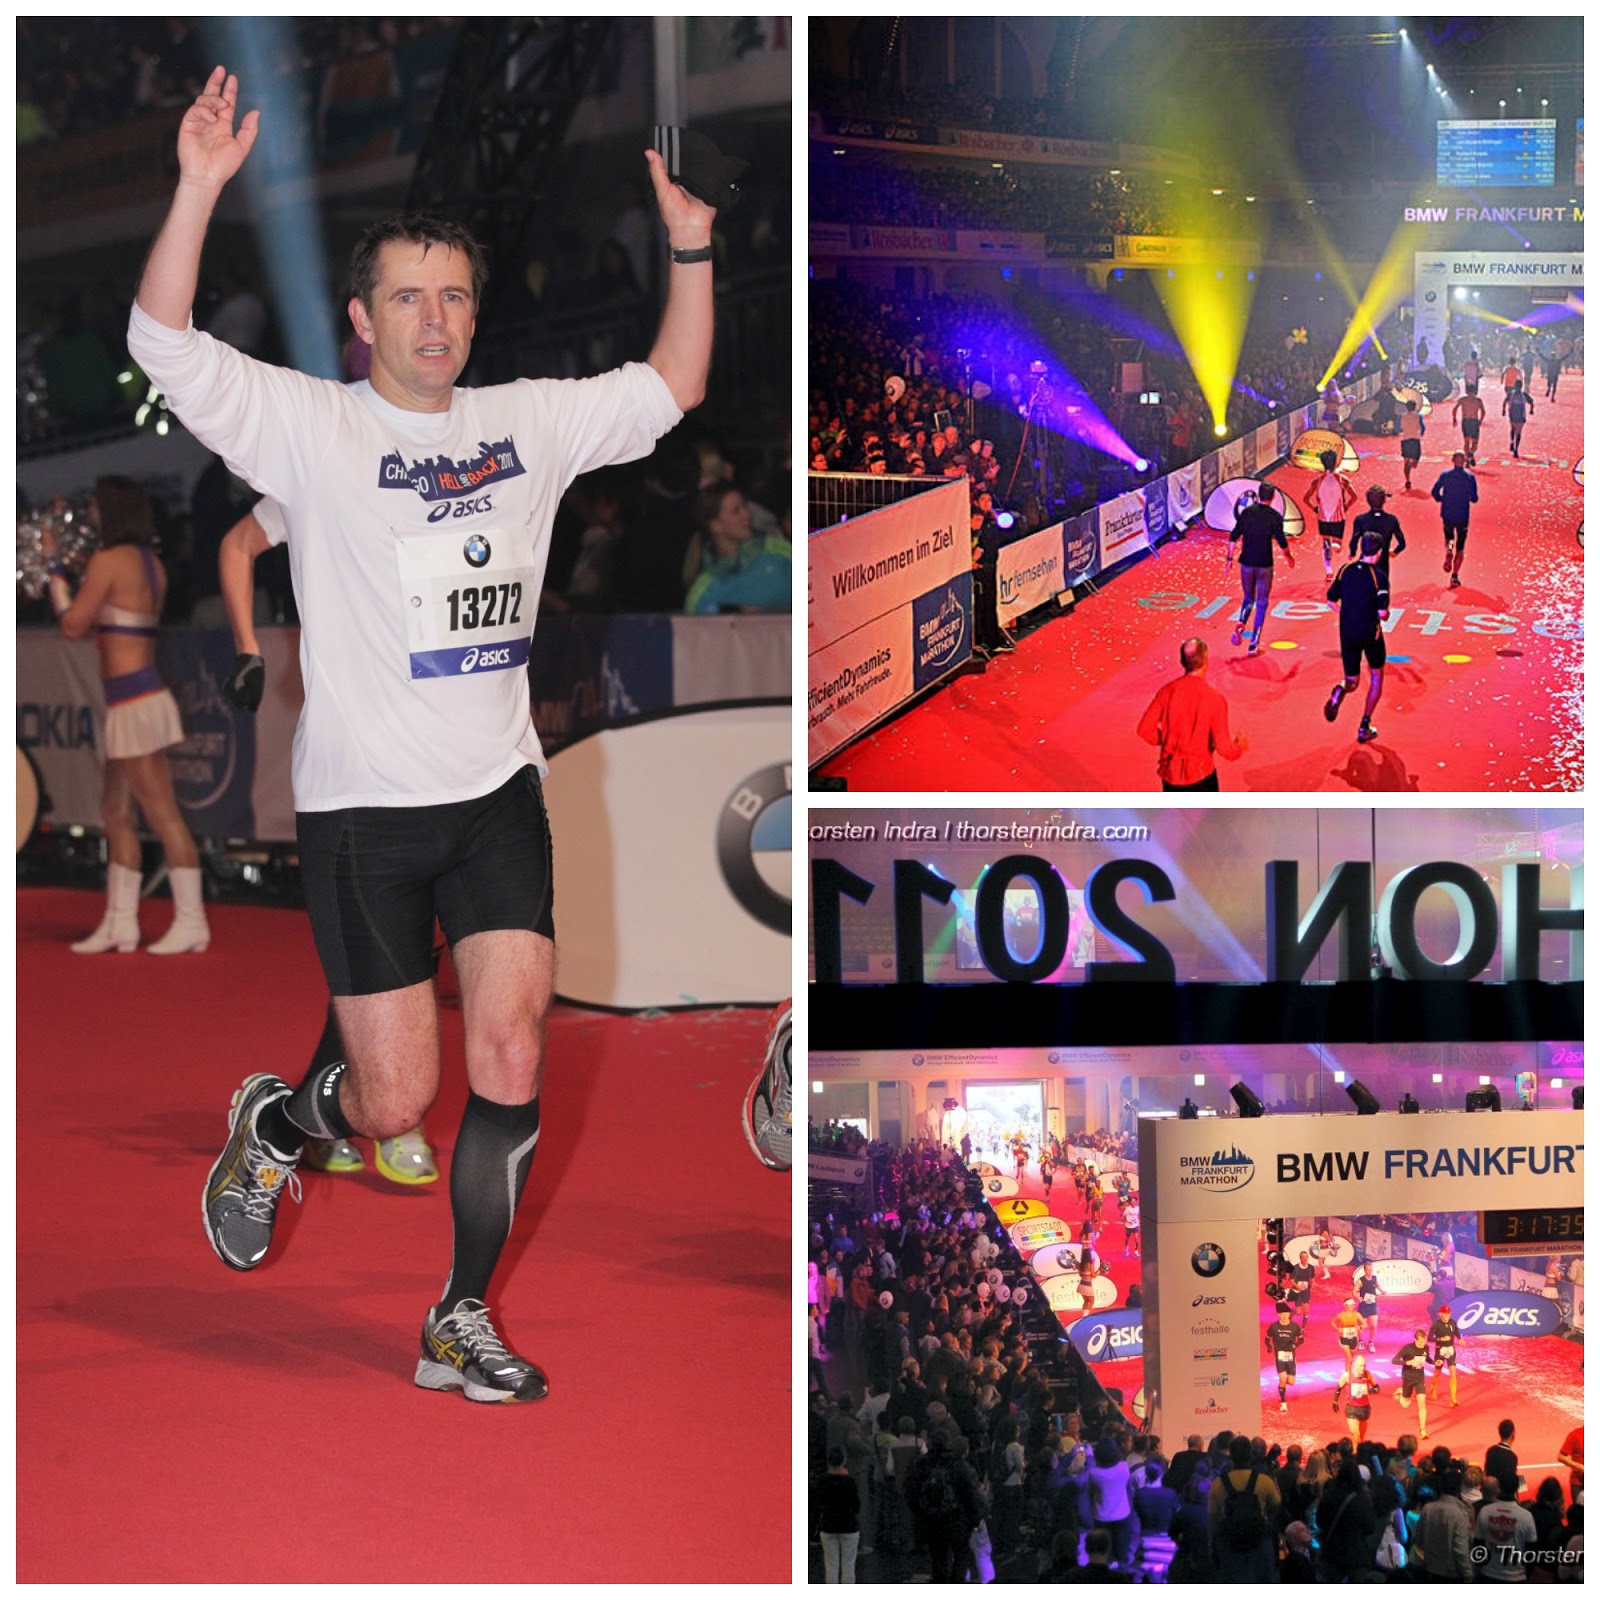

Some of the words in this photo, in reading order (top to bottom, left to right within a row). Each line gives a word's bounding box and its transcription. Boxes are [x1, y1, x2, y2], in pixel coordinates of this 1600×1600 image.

[1404, 208, 1448, 222] BMW
[1456, 207, 1566, 222] FRANKFURT
[1453, 263, 1486, 275] BMW
[1490, 263, 1567, 275] FRANKFURT
[438, 472, 464, 490] HELL
[467, 456, 500, 486] BACK
[497, 451, 515, 471] 2011
[453, 494, 493, 518] asics
[832, 548, 914, 599] Willkommen
[916, 539, 930, 559] im
[932, 525, 954, 553] Ziel
[447, 582, 522, 632] 13272
[919, 617, 940, 640] BMW
[480, 648, 510, 667] asics
[1180, 1156, 1211, 1167] BMW
[1276, 1151, 1369, 1183] BMW
[1191, 1166, 1249, 1176] FRANKFURT
[1180, 1176, 1238, 1185] MARATHON
[1510, 1245, 1545, 1253] FRANKFURT
[1380, 1275, 1421, 1287] sthalle
[1051, 1289, 1108, 1303] festle
[1203, 1296, 1226, 1305] asics
[1484, 1307, 1540, 1326] asics
[1191, 1324, 1230, 1335] festhalle
